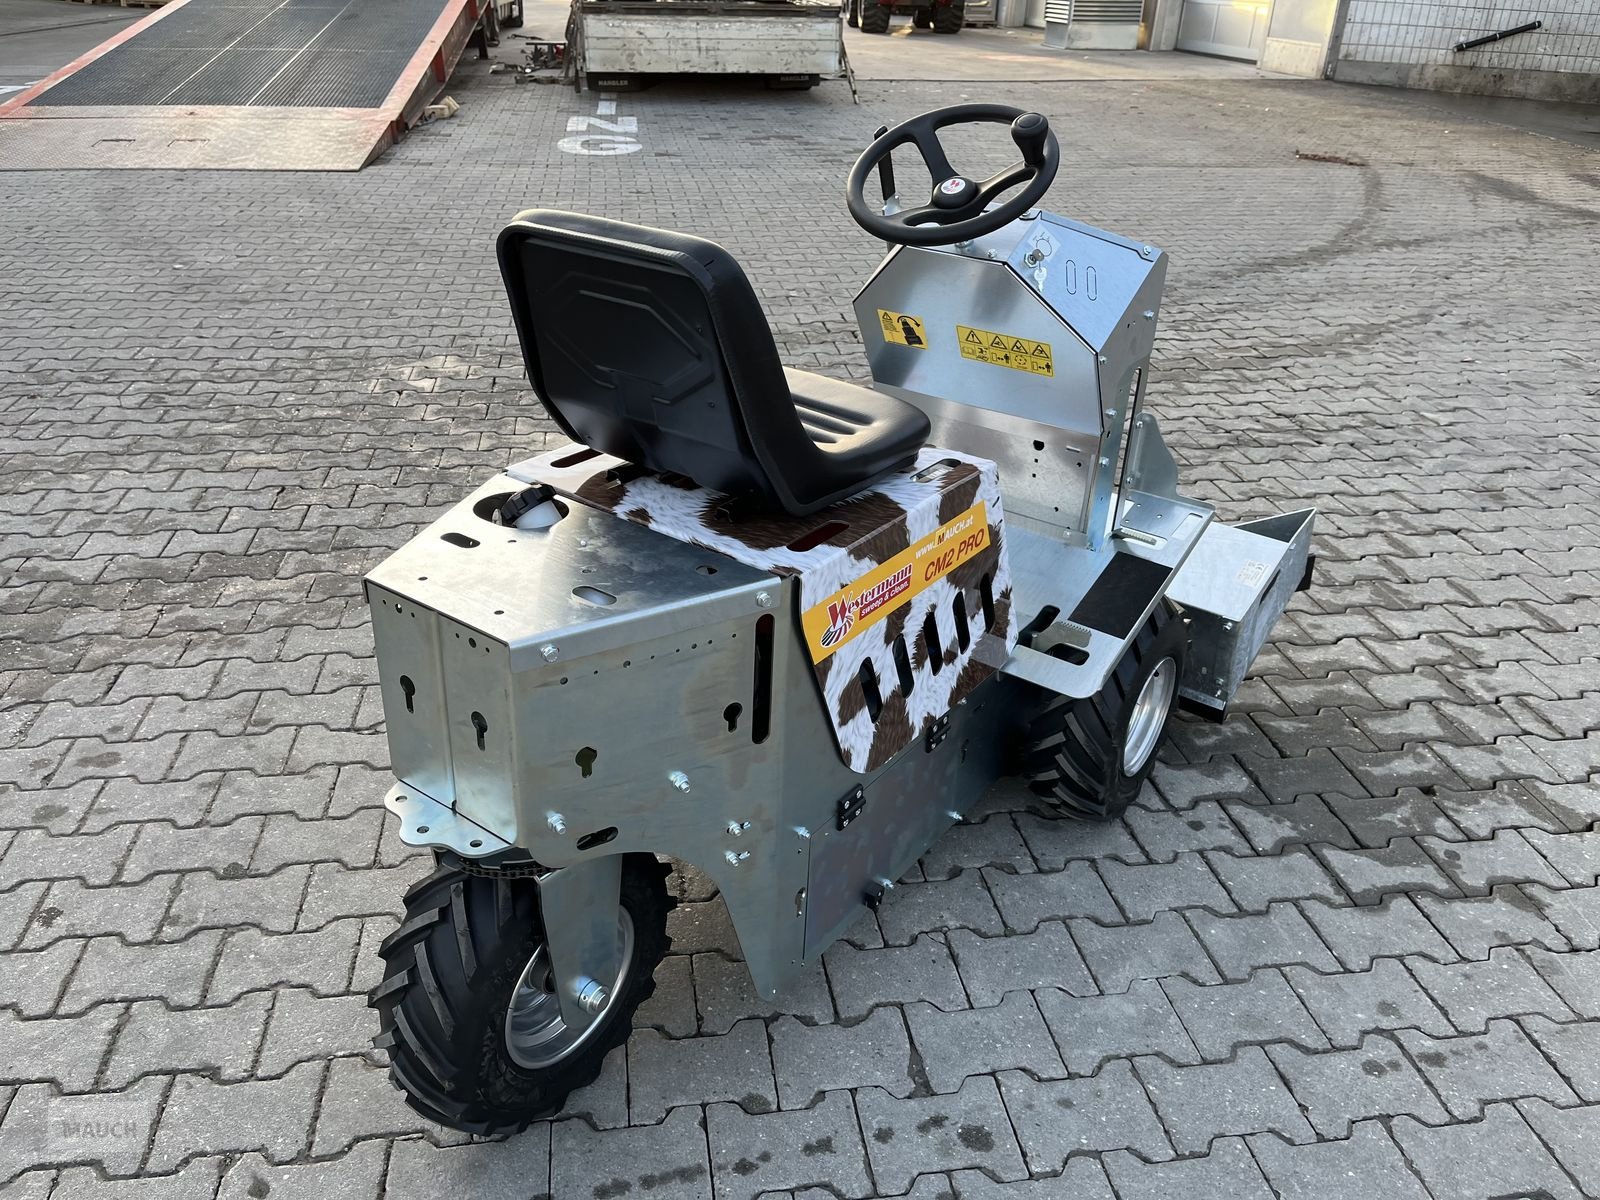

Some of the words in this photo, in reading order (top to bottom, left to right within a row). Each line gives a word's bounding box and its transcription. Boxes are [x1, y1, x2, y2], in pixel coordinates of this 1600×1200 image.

[924, 547, 955, 581] CM2
[956, 528, 985, 560] PRO
[827, 563, 913, 630] Westermann
[861, 597, 884, 617] sweep
